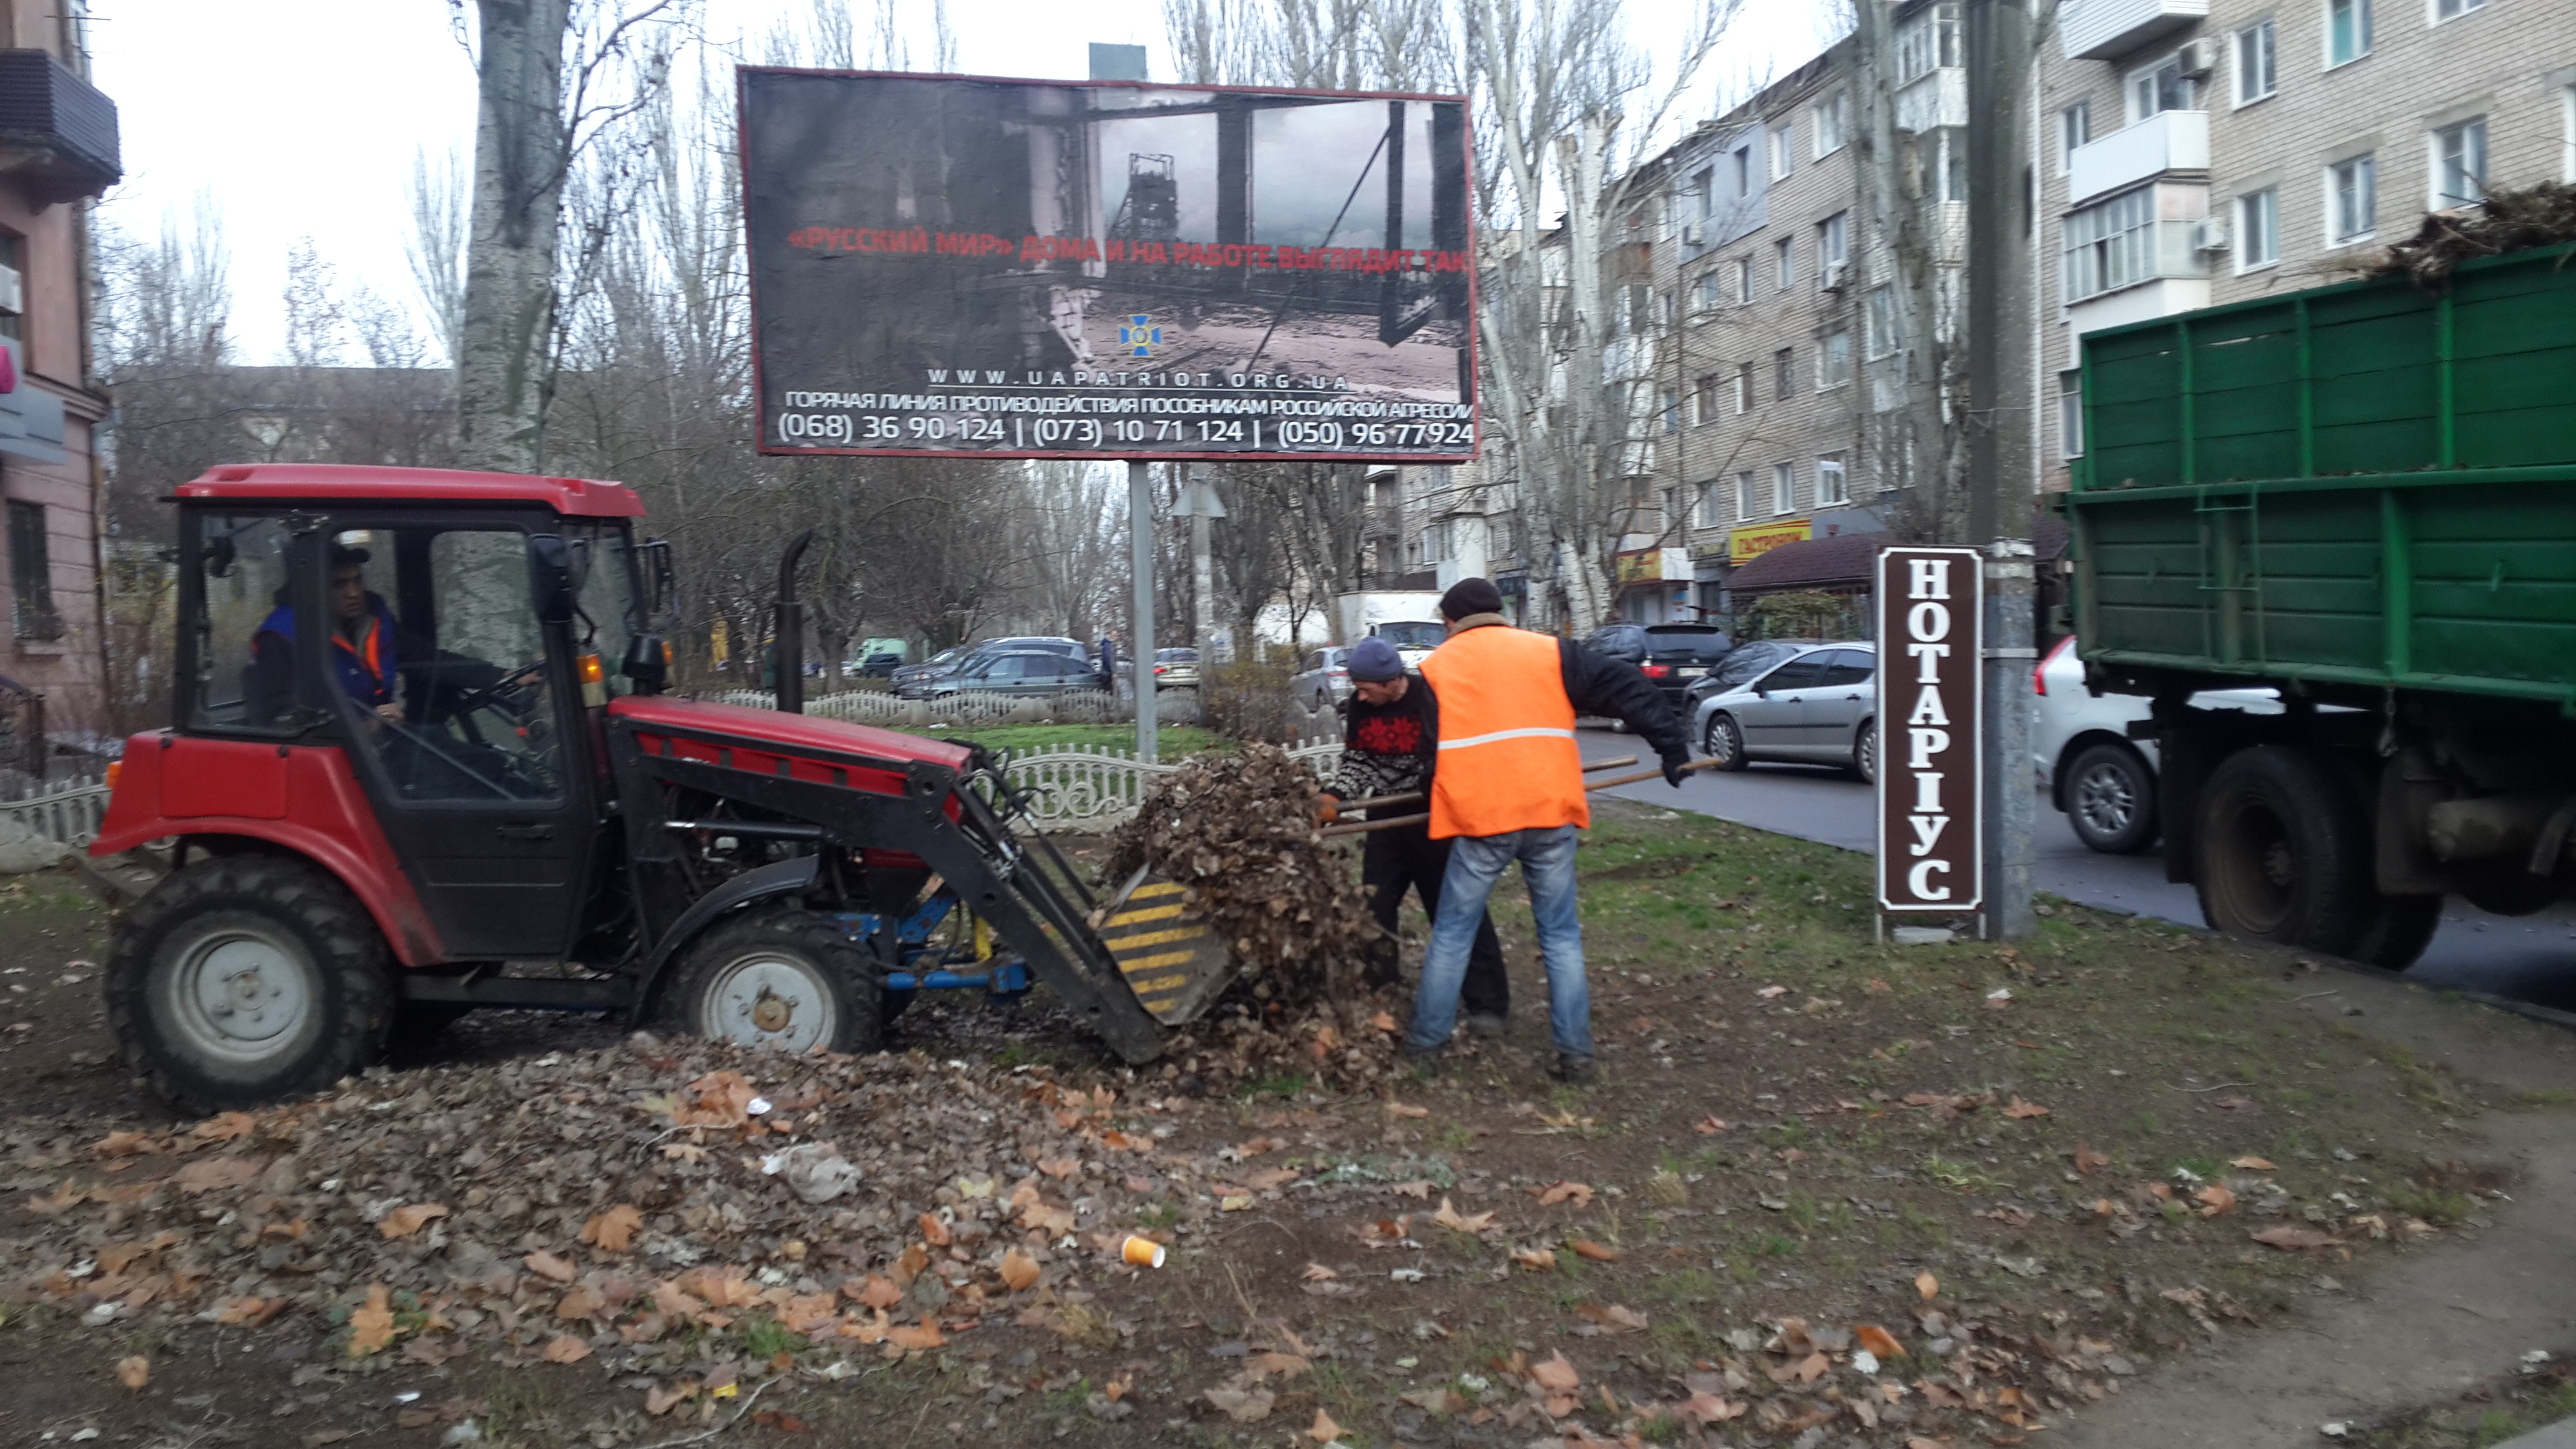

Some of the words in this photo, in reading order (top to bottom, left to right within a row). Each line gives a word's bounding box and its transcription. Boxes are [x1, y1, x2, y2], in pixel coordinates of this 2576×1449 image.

[788, 225, 929, 253] «РУССКИЙ
[936, 232, 1013, 256] МИР»
[1019, 235, 1101, 263] ДОМА
[1106, 239, 1124, 262] И
[1131, 240, 1168, 265] НА
[1174, 242, 1272, 268] РАБОТЕ
[1278, 246, 1415, 275] ВЫГЛЯДИТ
[1420, 251, 1468, 273] ТАК
[785, 391, 876, 409] ГОРЯЧАЯ
[879, 394, 947, 411] ЛИНИЯ
[950, 394, 1139, 415] ПРОТИВОДЕЙСТВИЯ
[1141, 398, 1269, 414] ПОСОБНИКАМ
[1271, 398, 1387, 417] РОССИЙСКОЙ
[780, 412, 853, 442] (068)
[862, 416, 900, 438] 36
[908, 417, 945, 439] 90
[957, 418, 1005, 440] 124
[1033, 417, 1103, 447] (073)
[1113, 420, 1144, 441] 10
[1153, 419, 1183, 441] 71
[1197, 420, 1244, 442] 124
[1278, 421, 1343, 449] (050)
[1351, 422, 1387, 445] 96
[1906, 559, 1951, 900] НОТАРІУС
